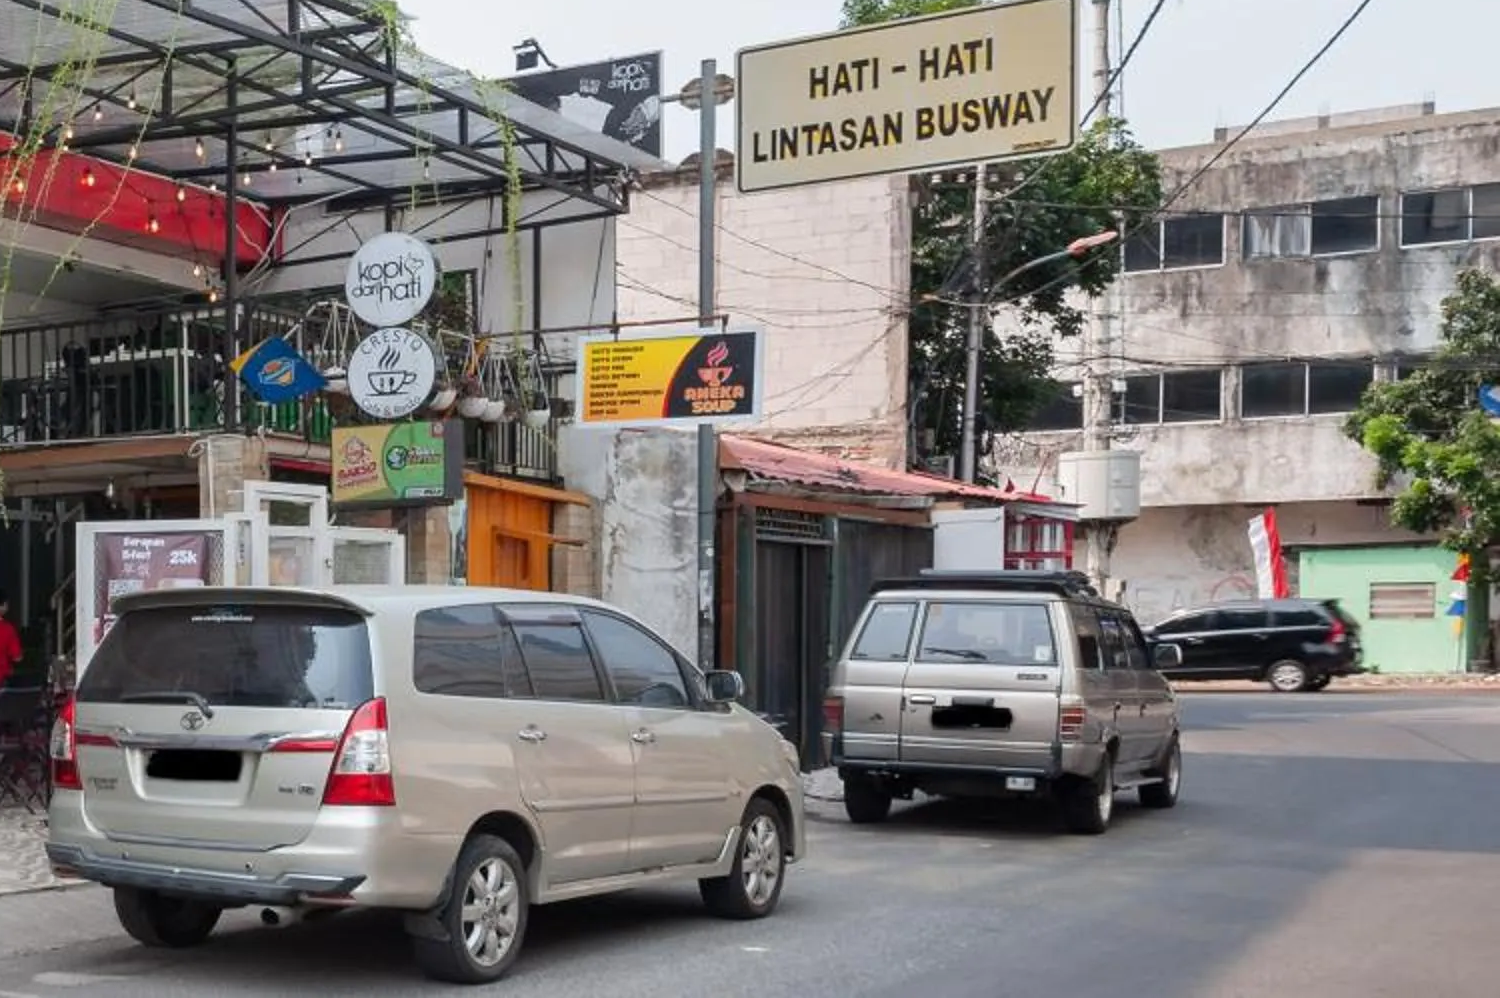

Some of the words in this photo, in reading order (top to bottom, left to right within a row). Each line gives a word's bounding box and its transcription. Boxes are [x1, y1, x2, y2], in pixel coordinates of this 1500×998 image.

[809, 57, 880, 99] HATI
[919, 38, 993, 82] HATI
[753, 110, 902, 163] LINTASAN
[916, 87, 1055, 141] BUSWAY
[357, 256, 404, 284] kopi
[378, 277, 422, 303] hati
[360, 332, 424, 356] CRESTO
[683, 385, 745, 401] ANEKA
[691, 399, 737, 414] SOUP
[169, 548, 198, 564] 25k
